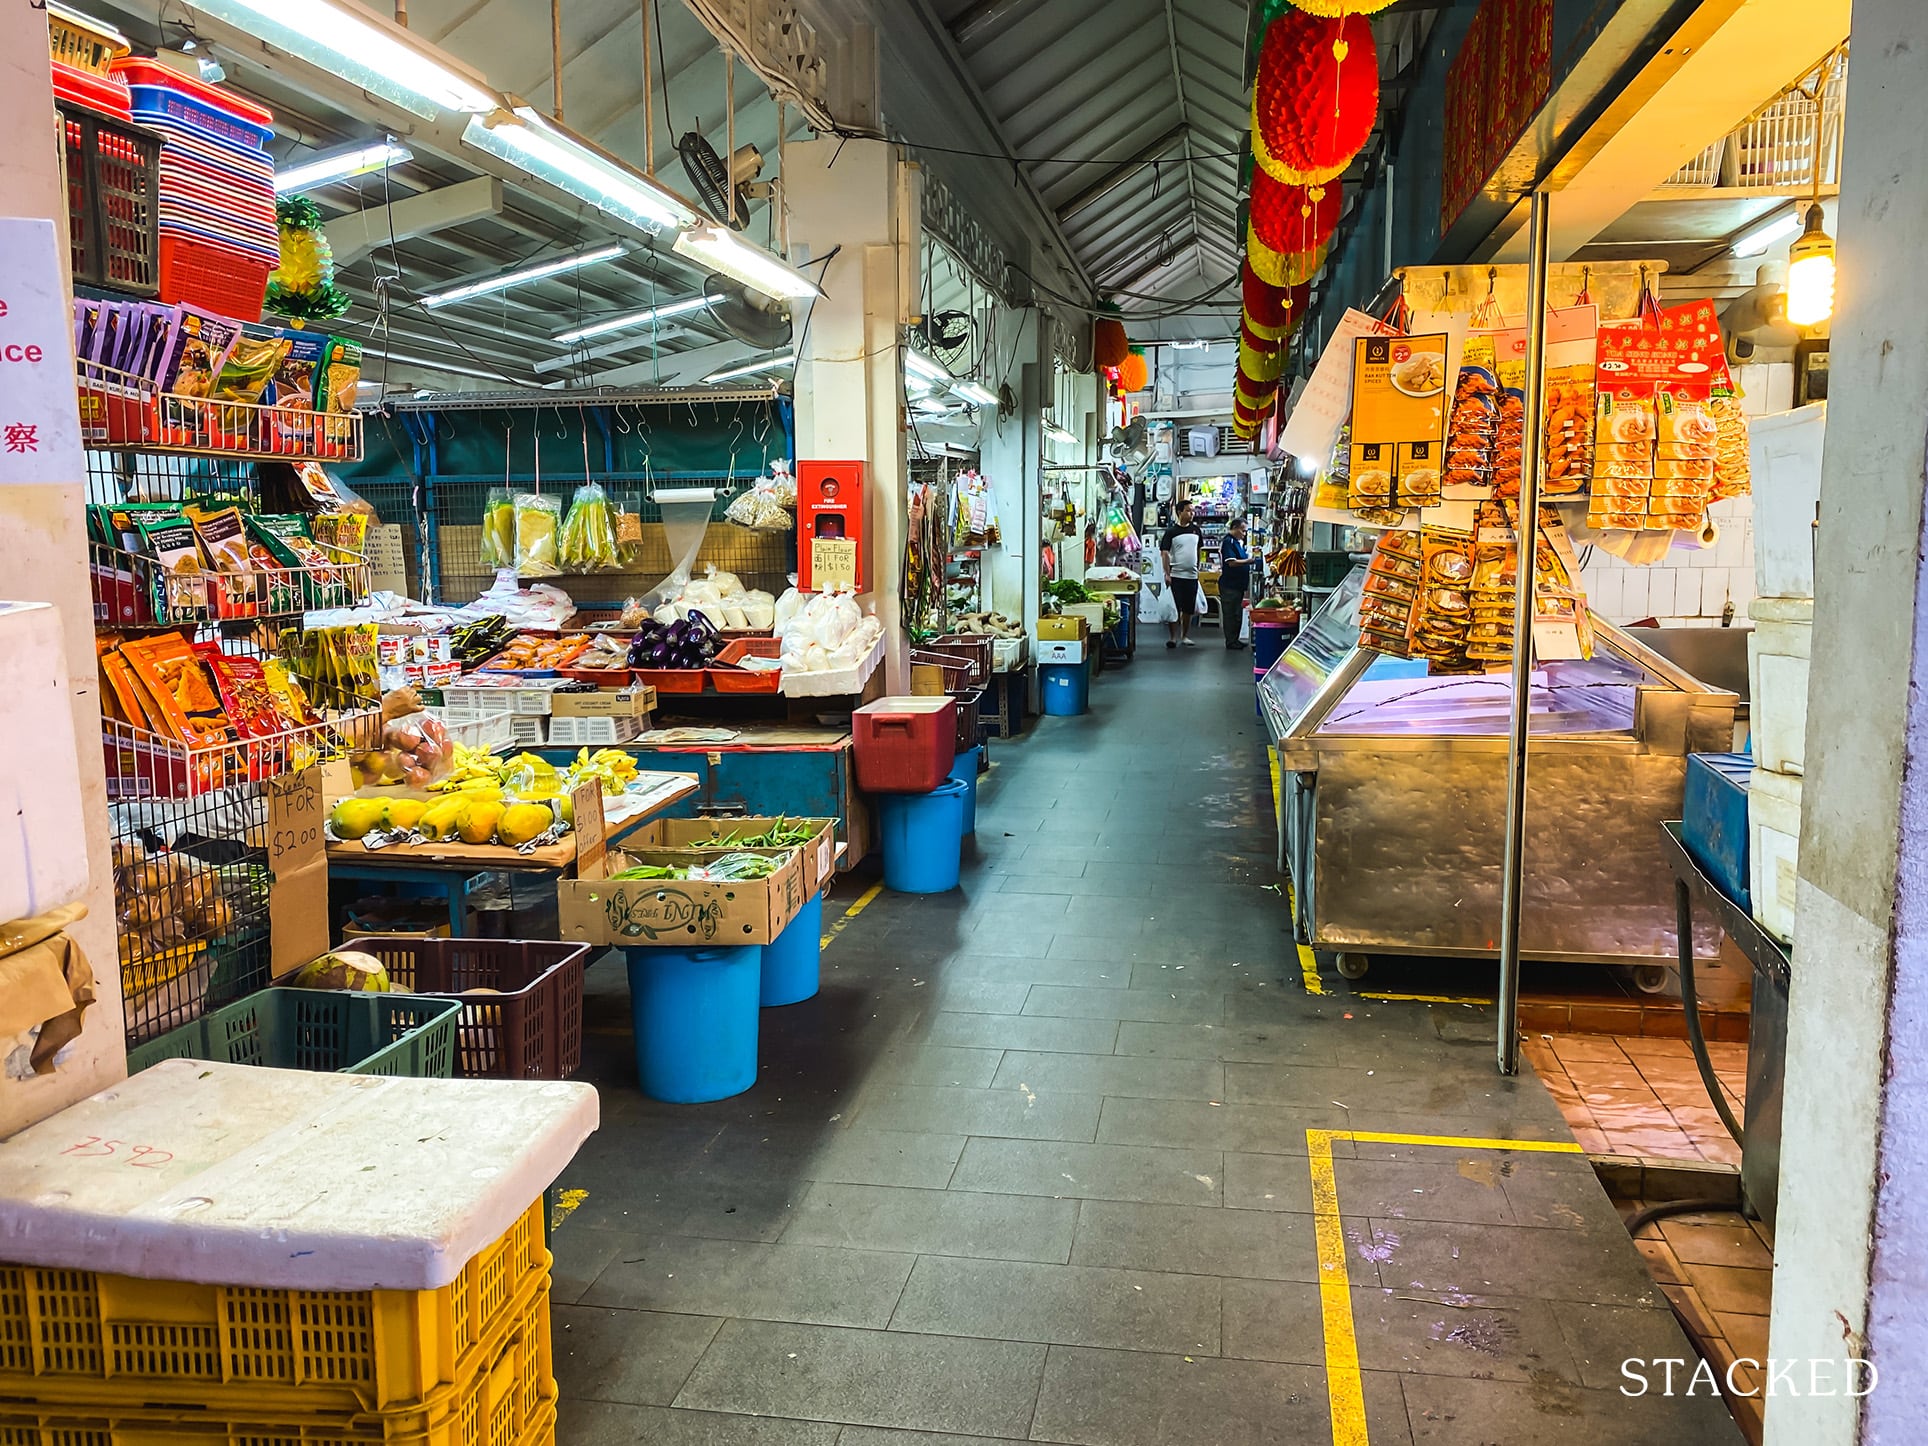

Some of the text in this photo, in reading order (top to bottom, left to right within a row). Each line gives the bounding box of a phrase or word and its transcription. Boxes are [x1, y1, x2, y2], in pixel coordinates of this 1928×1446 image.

[0, 343, 43, 363] ce
[833, 554, 849, 562] FOR
[286, 786, 315, 818] FOR
[580, 781, 597, 804] FOR
